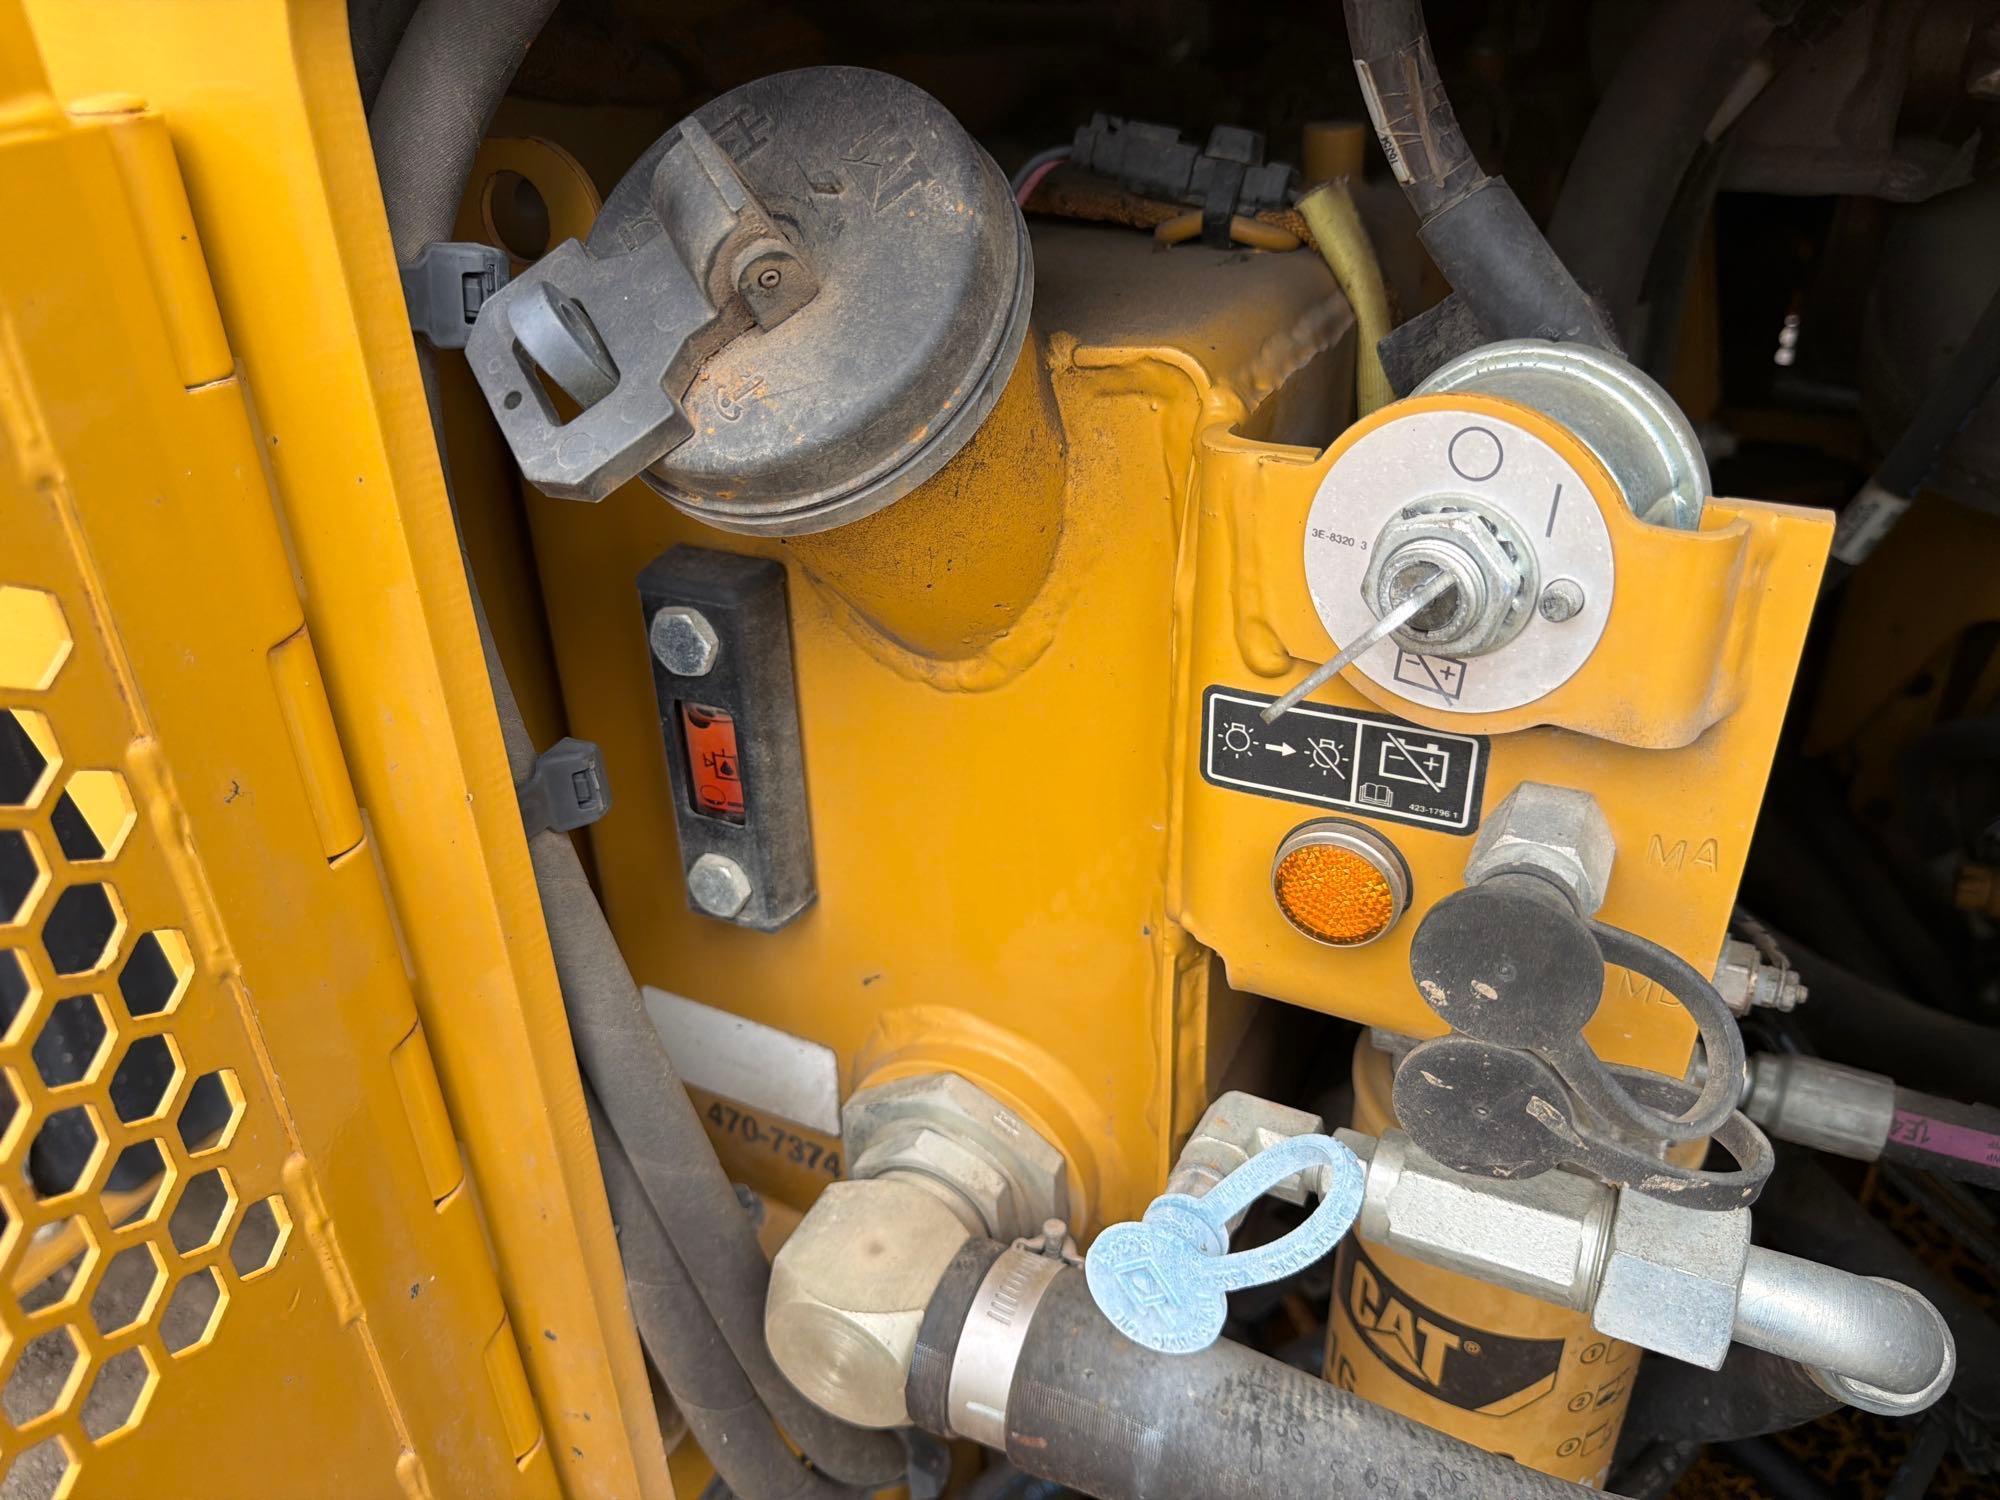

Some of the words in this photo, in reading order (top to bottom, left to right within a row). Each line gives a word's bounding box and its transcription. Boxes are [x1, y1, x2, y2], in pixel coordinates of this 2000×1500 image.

[1312, 528, 1355, 547] 3E-8320
[1360, 540, 1368, 550] 3
[1408, 804, 1450, 817] 423-1796
[1648, 833, 1719, 873] MA
[708, 1102, 840, 1178] 470-7374
[1351, 1258, 1461, 1388] CAT
